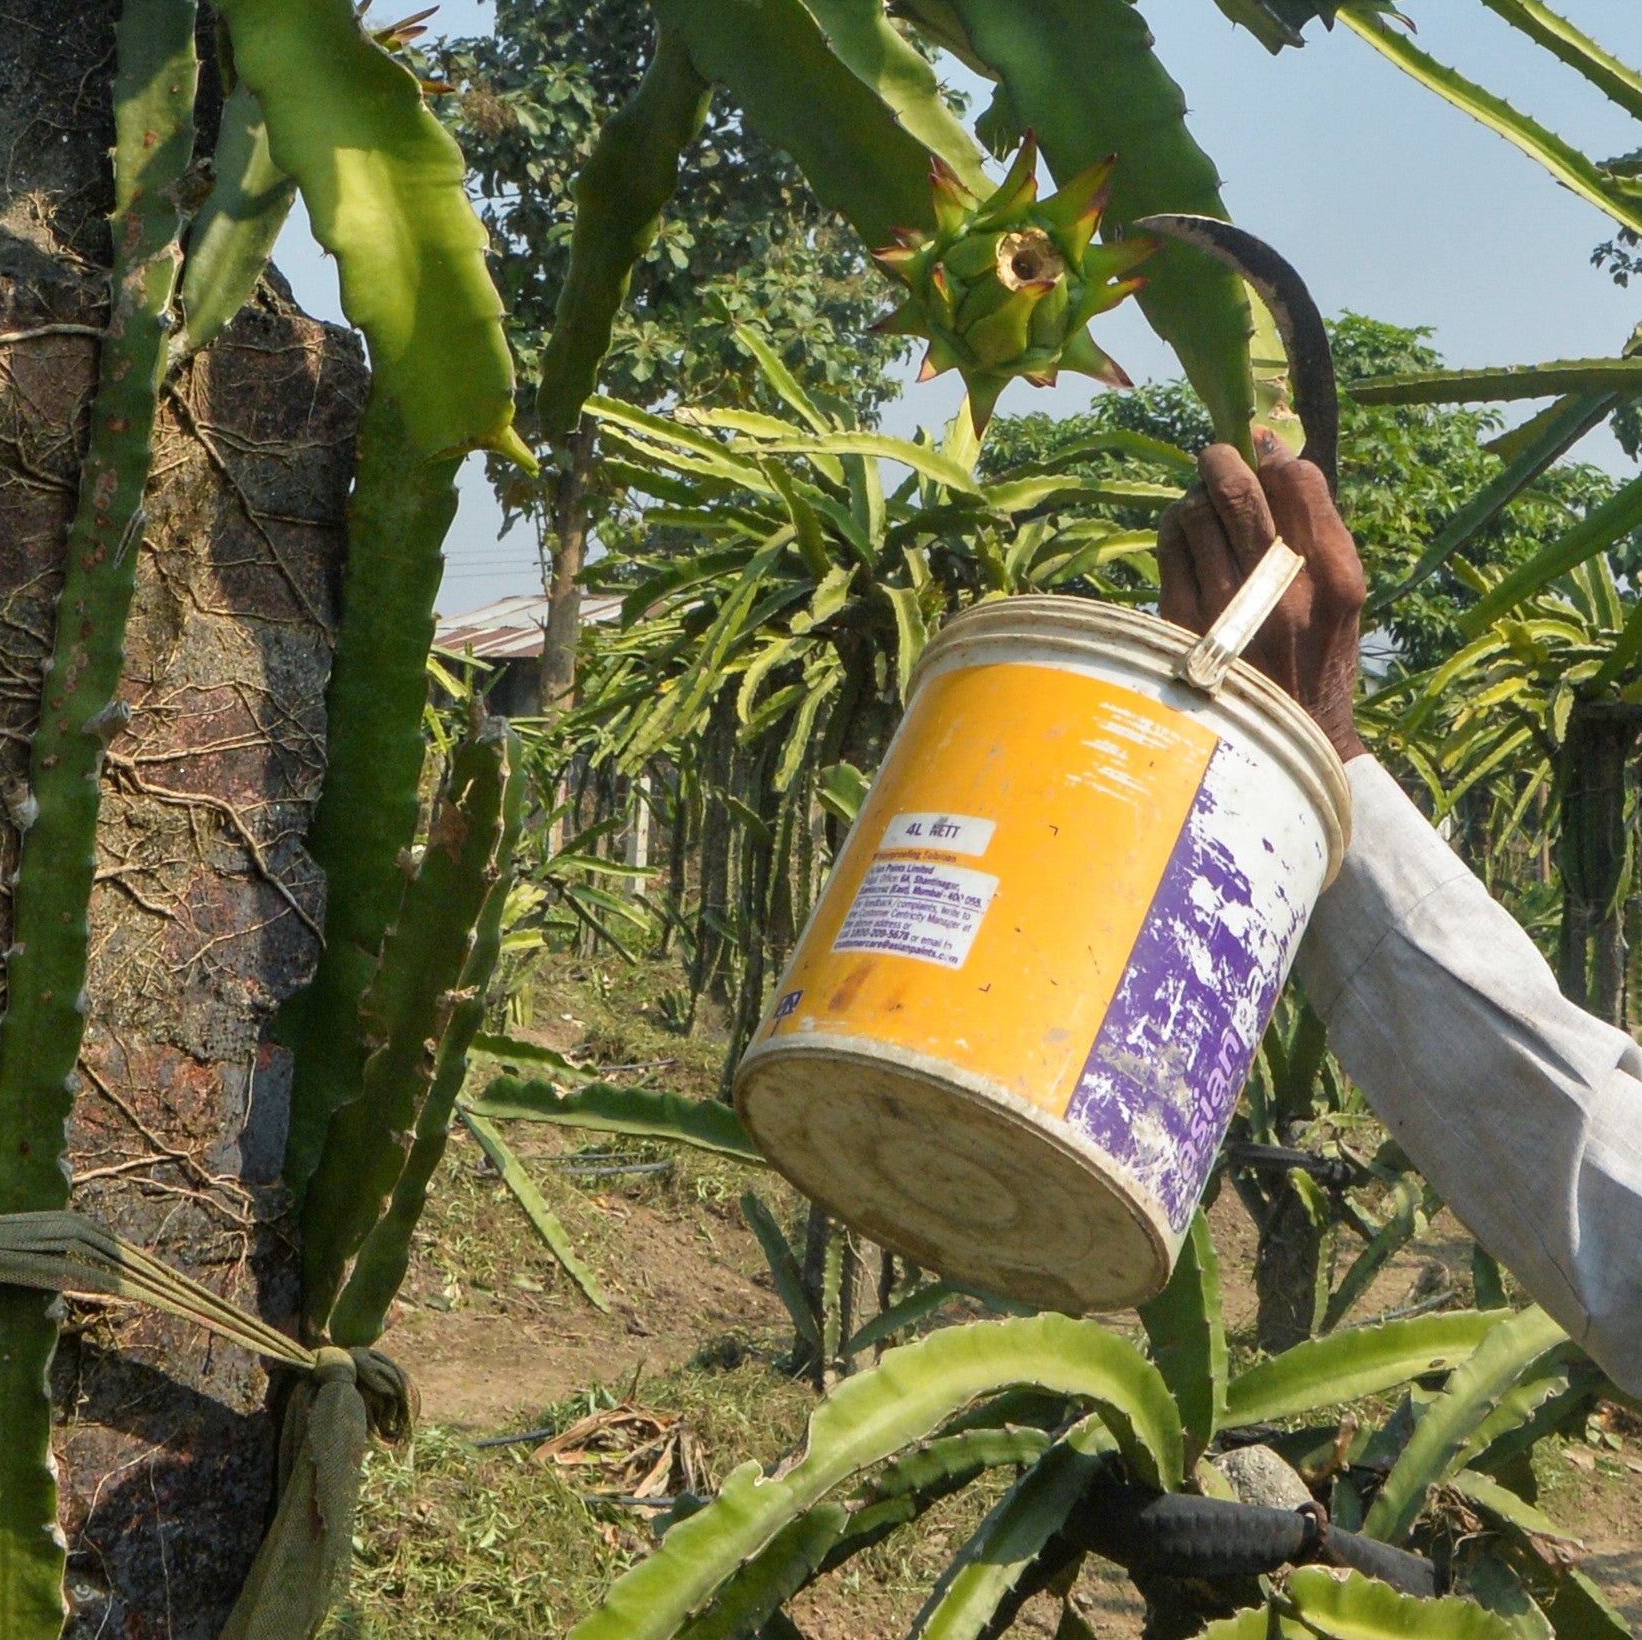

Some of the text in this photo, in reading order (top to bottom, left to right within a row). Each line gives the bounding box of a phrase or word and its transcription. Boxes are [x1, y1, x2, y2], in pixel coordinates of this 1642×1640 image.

[906, 822, 961, 839] 4L NETT
[962, 911, 971, 921] to
